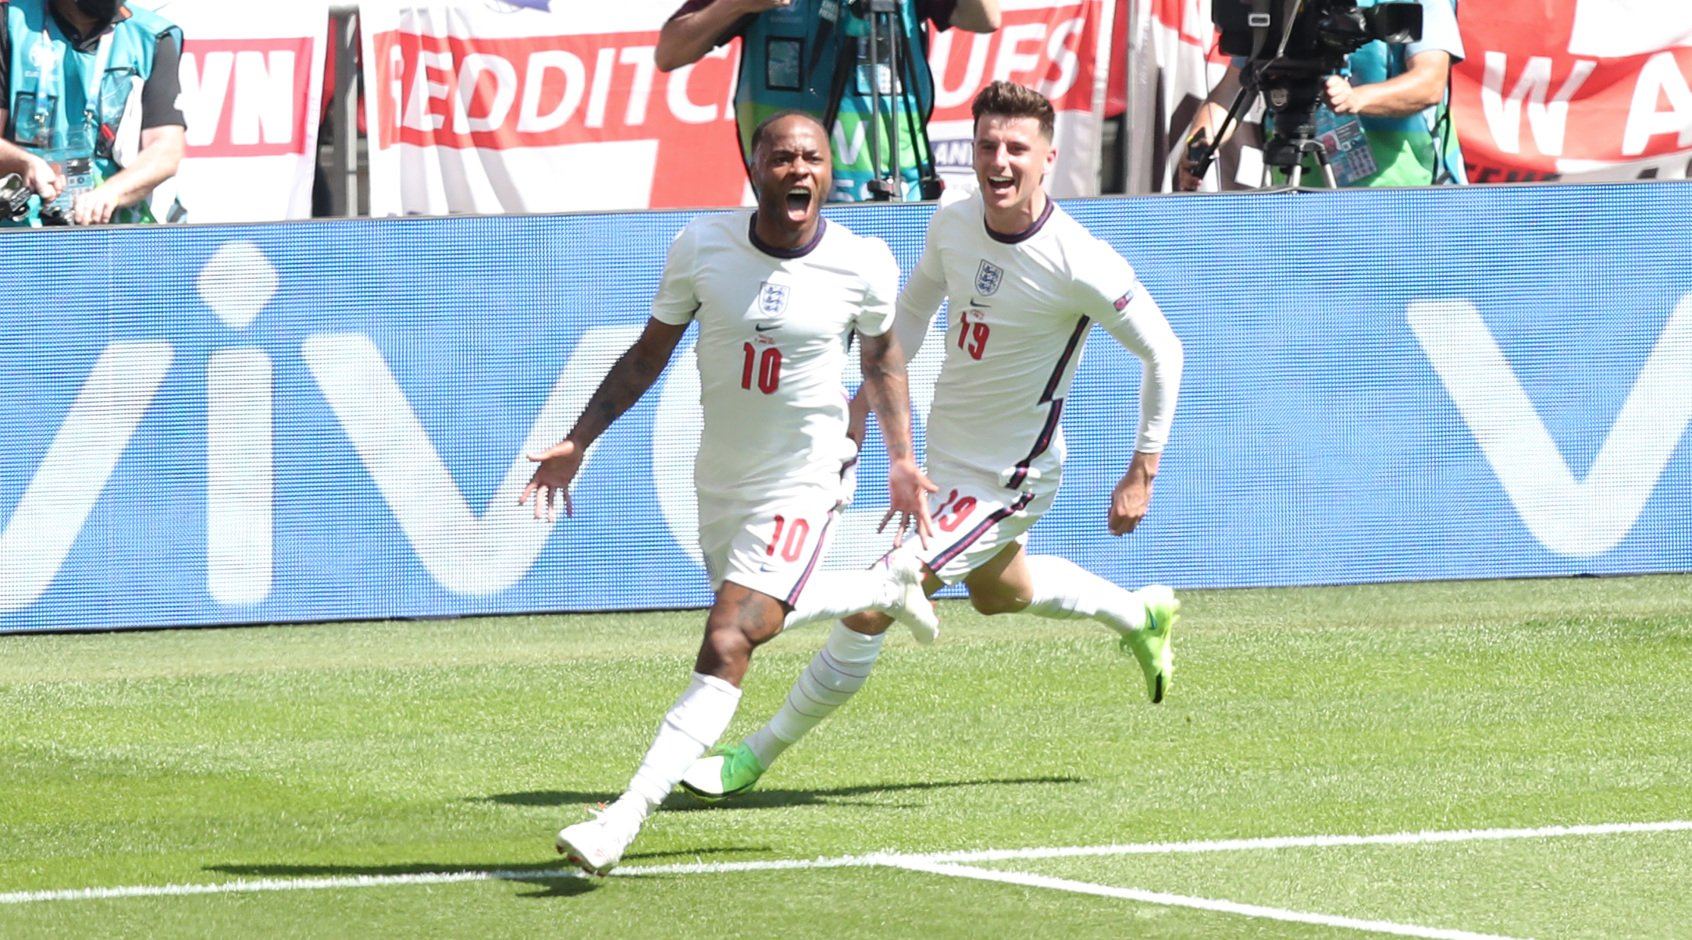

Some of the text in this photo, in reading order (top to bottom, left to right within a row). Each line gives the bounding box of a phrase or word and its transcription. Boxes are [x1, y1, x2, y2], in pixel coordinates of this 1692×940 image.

[957, 311, 990, 361] 19
[741, 341, 783, 395] 10
[930, 488, 977, 532] 19
[766, 514, 810, 563] 10
